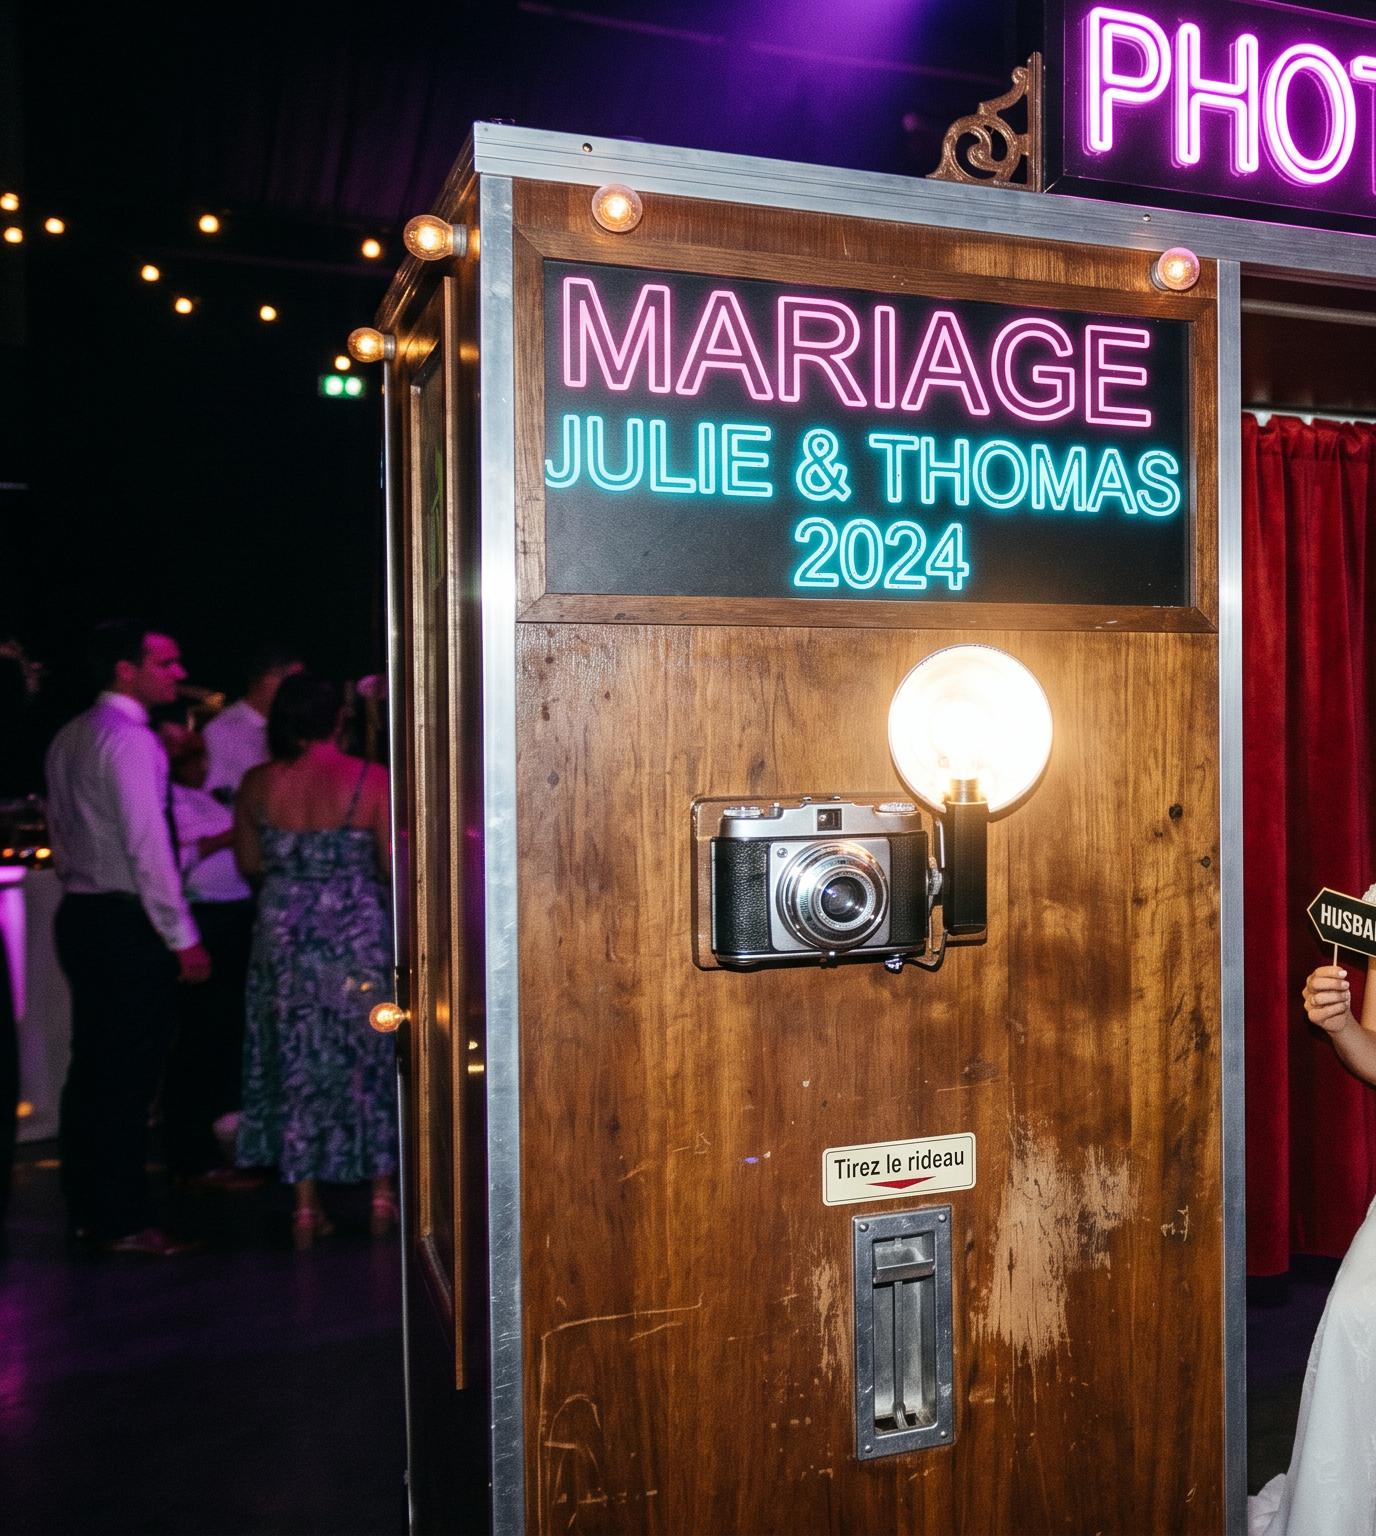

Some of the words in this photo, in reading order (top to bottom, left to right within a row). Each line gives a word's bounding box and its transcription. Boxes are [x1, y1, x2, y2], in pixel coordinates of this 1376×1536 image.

[563, 277, 1152, 428] MARIAGE
[545, 414, 772, 498] JULIE
[795, 428, 852, 502] &
[869, 433, 1181, 517] THOMAS
[794, 517, 969, 591] 2024
[833, 1158, 880, 1179] Tirez
[886, 1153, 902, 1174] le
[908, 1149, 964, 1171] rideau
